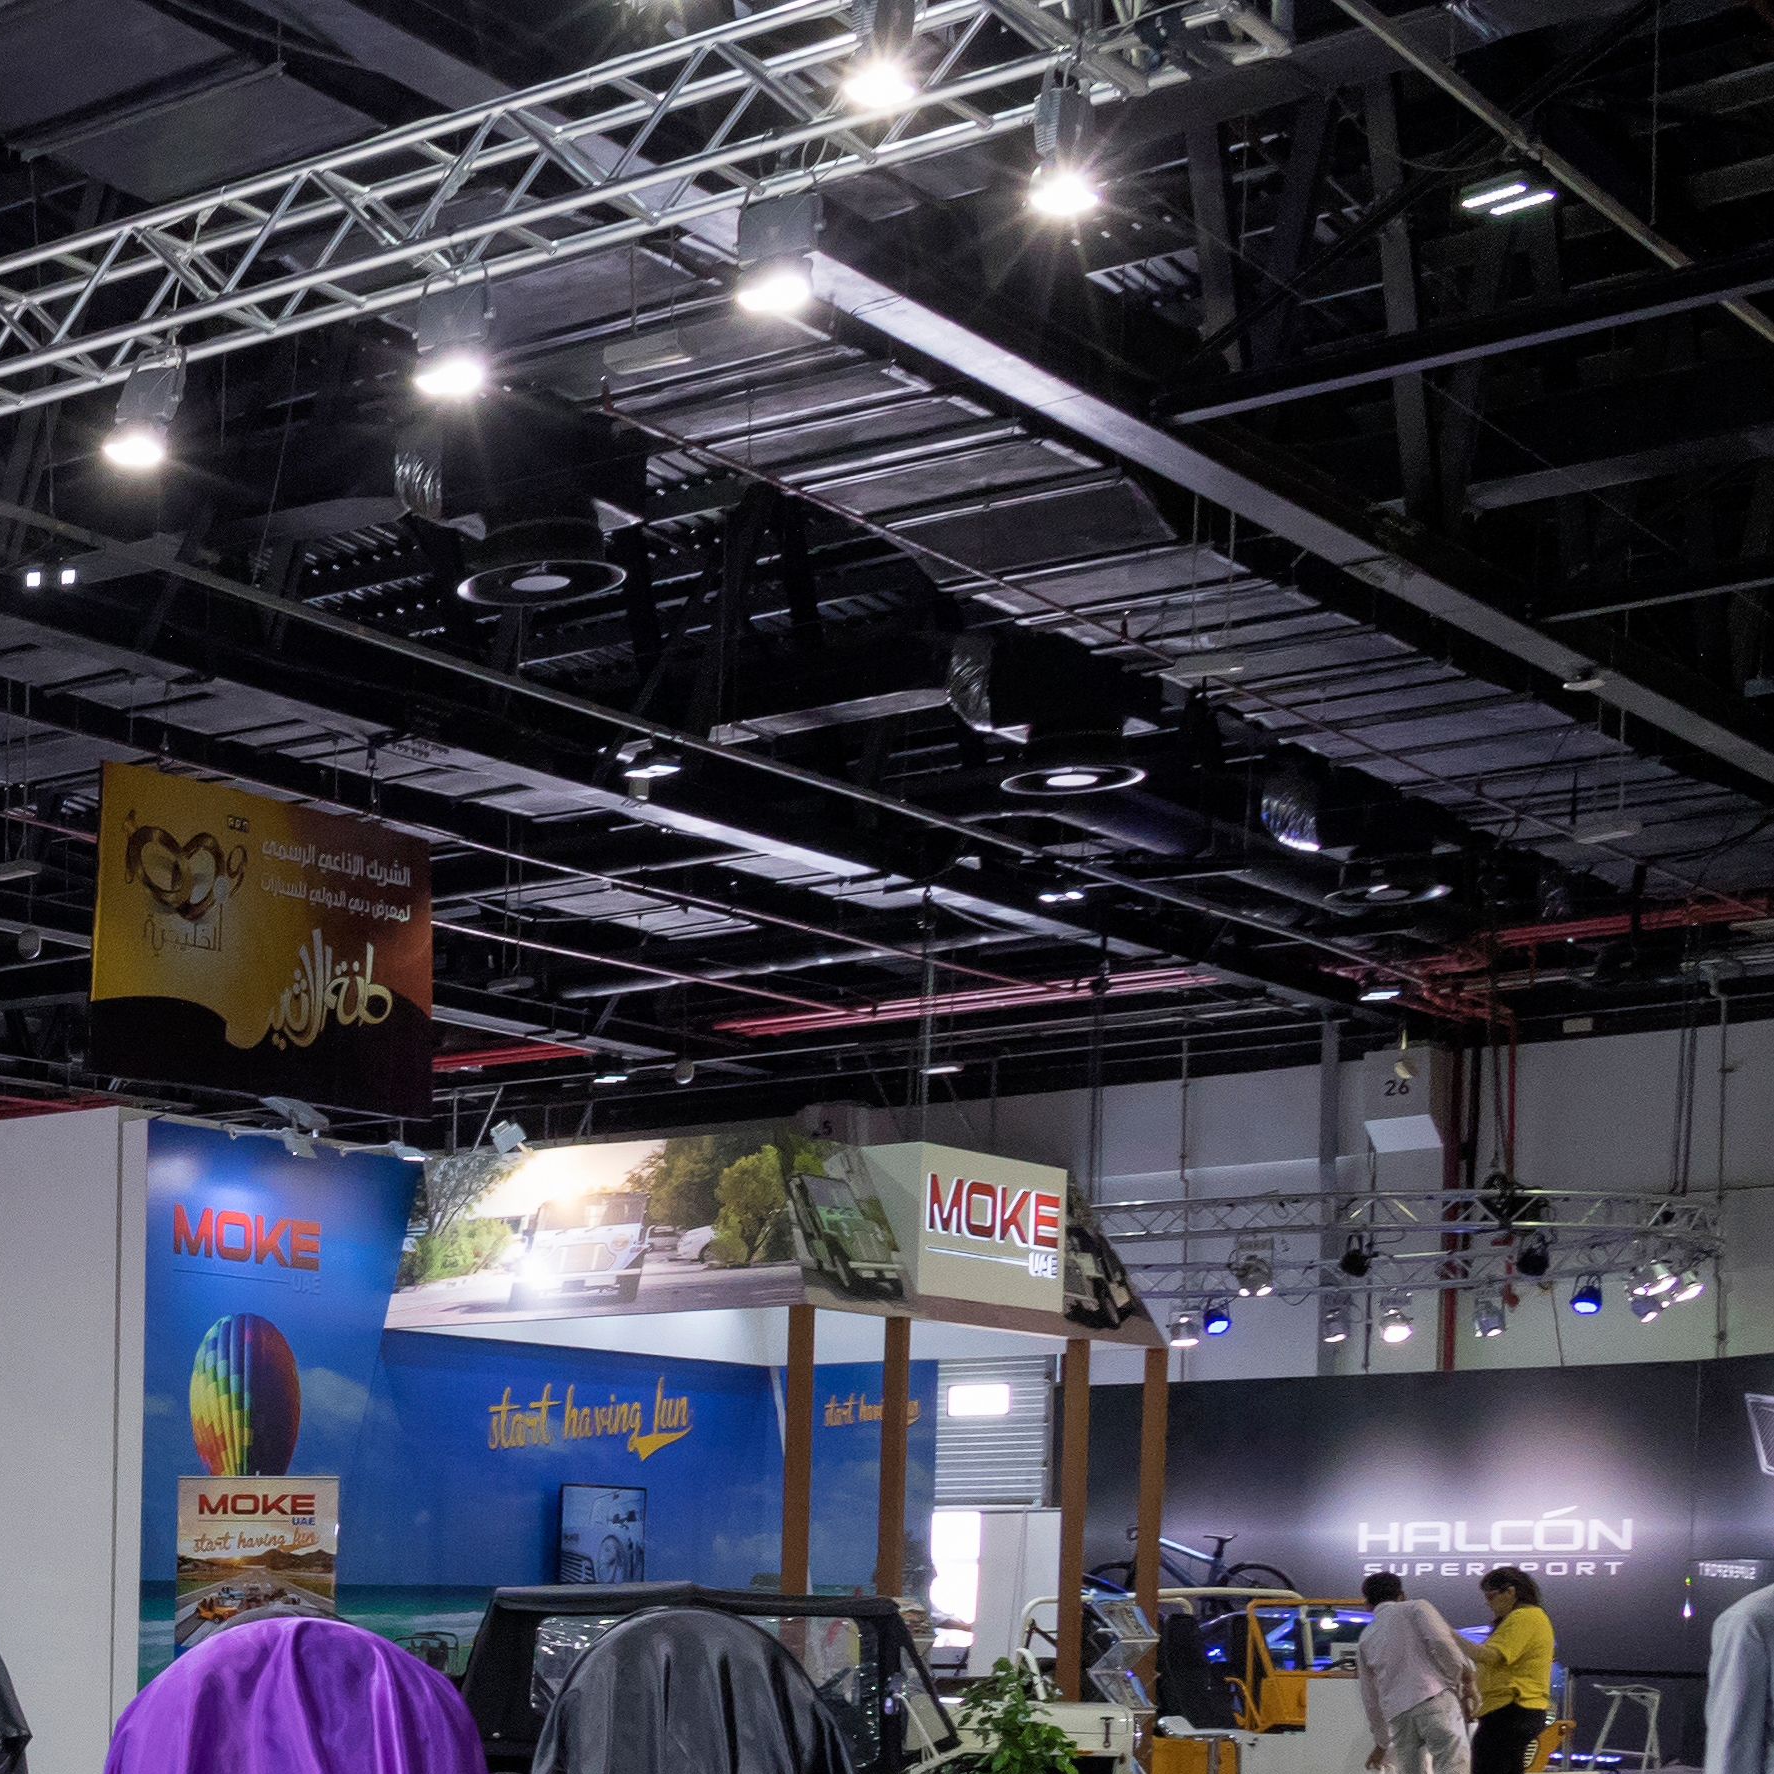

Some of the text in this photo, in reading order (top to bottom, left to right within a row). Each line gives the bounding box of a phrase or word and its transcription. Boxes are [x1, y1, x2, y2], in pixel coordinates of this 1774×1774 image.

[1384, 1080, 1409, 1096] 26
[926, 1171, 1061, 1251] MOKE
[174, 1204, 321, 1271] MOKE
[1028, 1251, 1059, 1279] UAE
[488, 1383, 562, 1449] start
[563, 1384, 642, 1453] having
[198, 1494, 316, 1515] MOKE
[291, 1517, 316, 1526] UAE
[1358, 1506, 1633, 1553] HALCÓN
[194, 1531, 235, 1553] start
